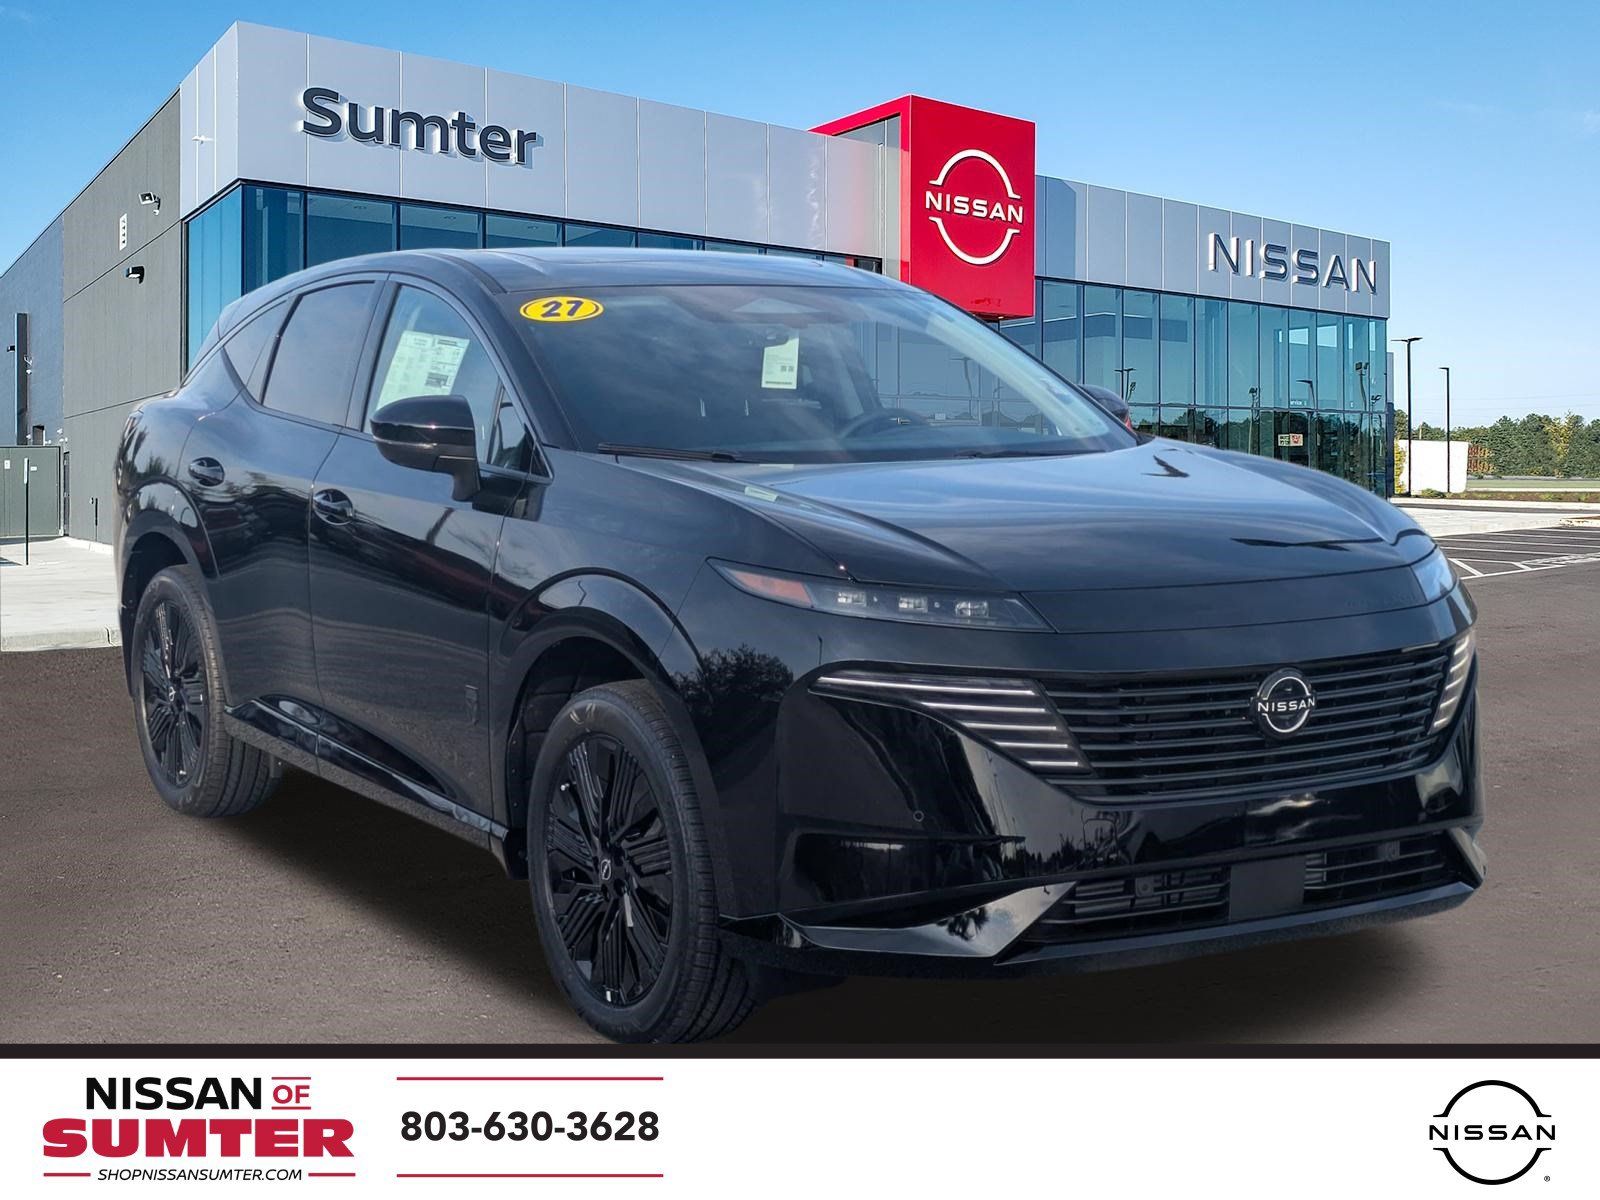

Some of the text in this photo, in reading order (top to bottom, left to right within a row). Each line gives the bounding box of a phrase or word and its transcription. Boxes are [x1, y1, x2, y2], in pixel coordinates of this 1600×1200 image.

[302, 87, 537, 164] Sumter
[925, 190, 1023, 223] NISSAN
[1208, 232, 1377, 294] NISSAN
[541, 300, 584, 318] 27
[1257, 696, 1315, 712] NISSAN
